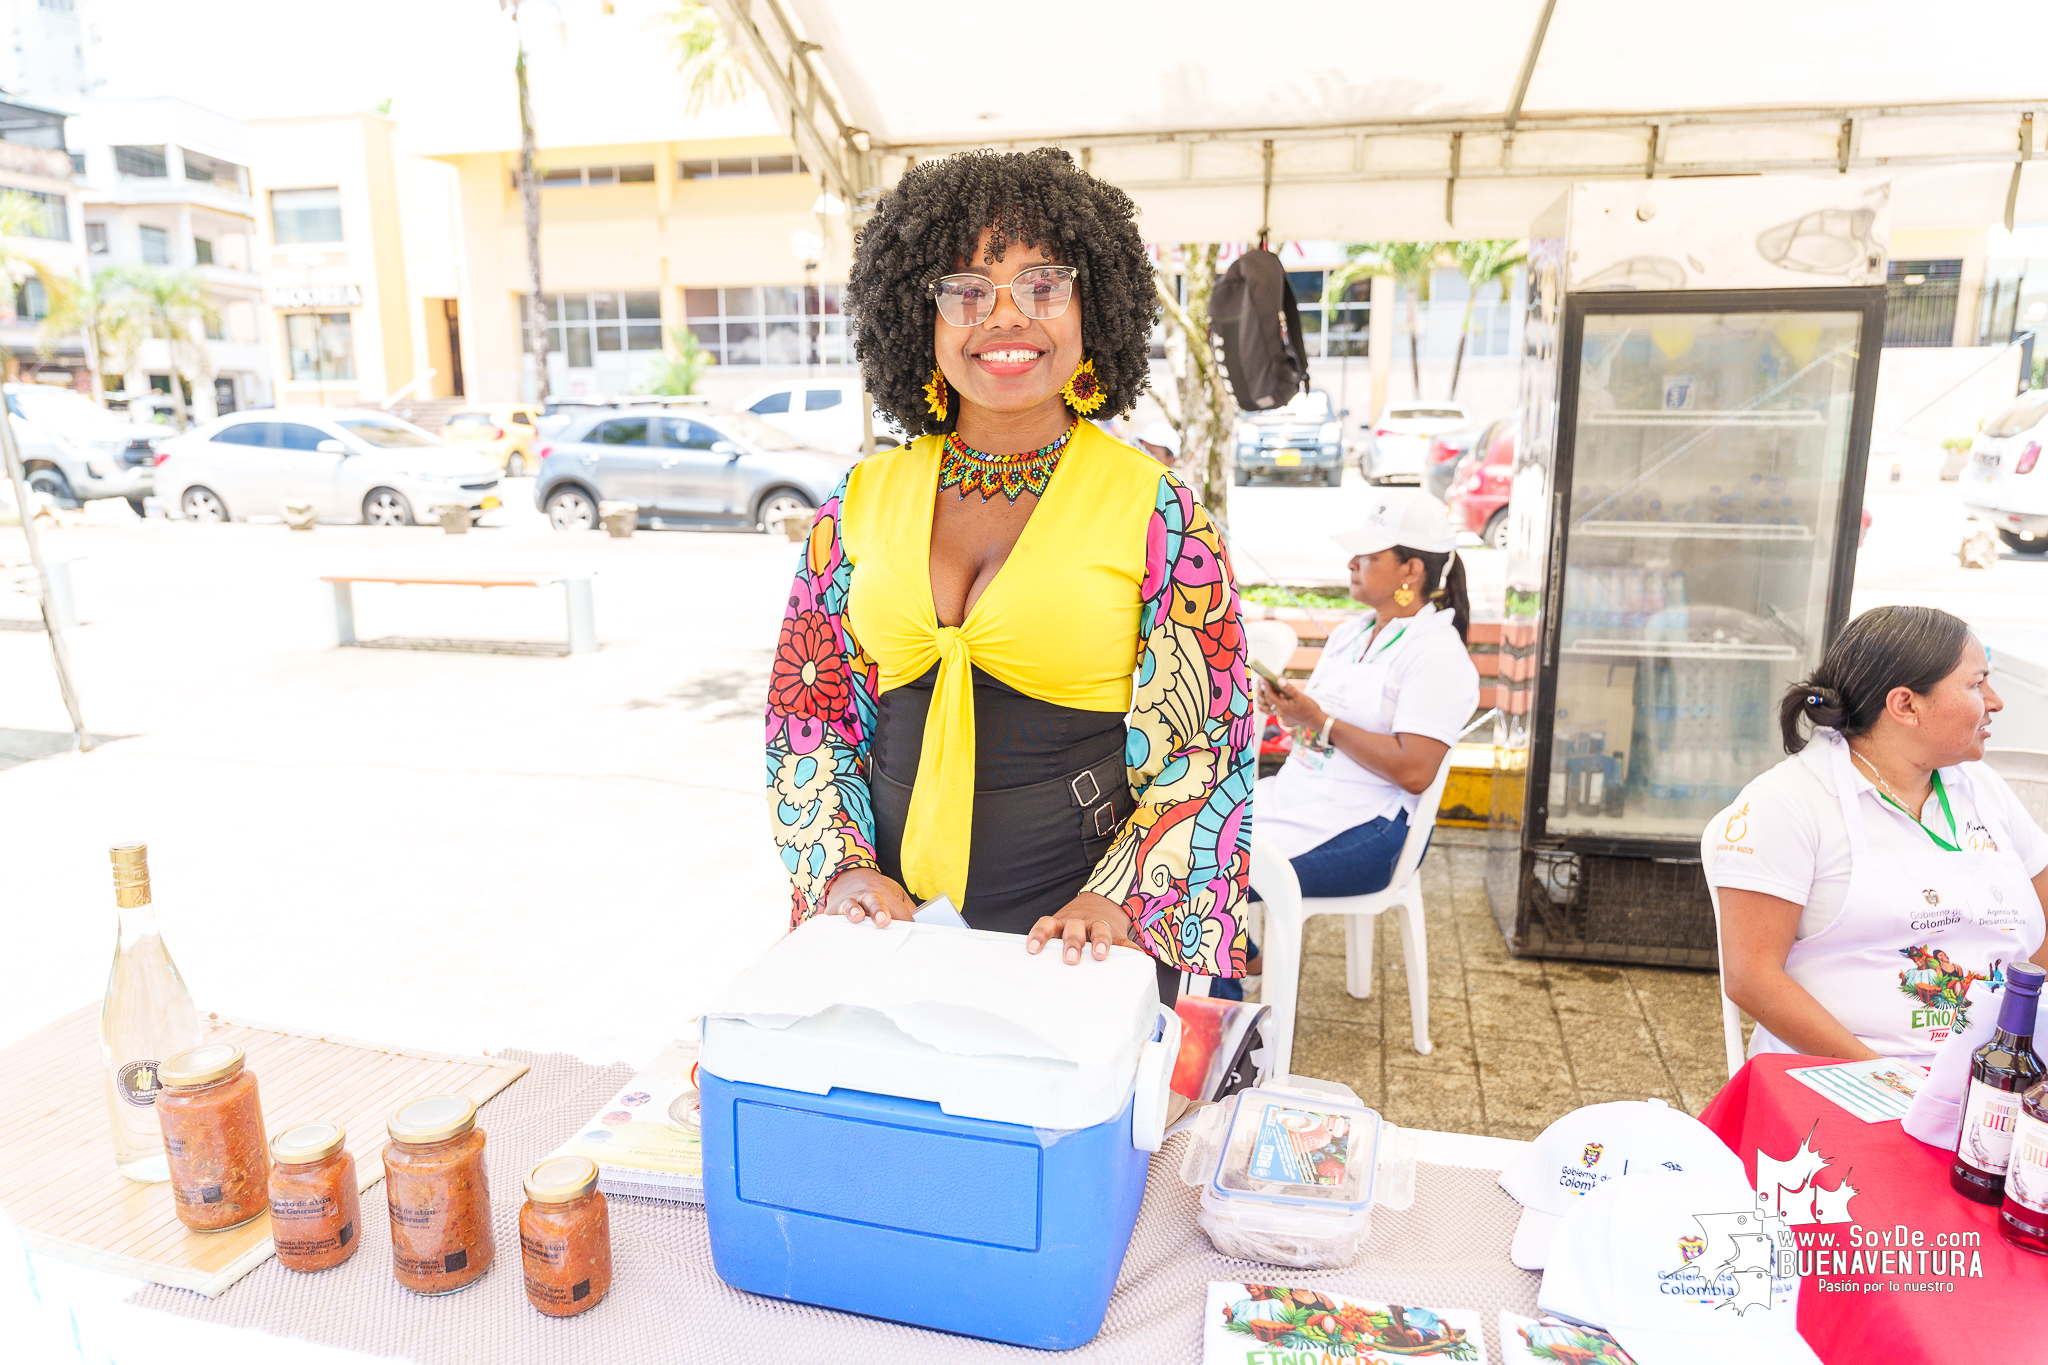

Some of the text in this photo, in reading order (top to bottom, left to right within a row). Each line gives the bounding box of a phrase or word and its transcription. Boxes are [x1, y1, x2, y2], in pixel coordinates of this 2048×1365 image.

[1910, 908, 1963, 920] Gobierno de
[1911, 916, 1961, 931] Colombia
[1985, 1101, 2018, 1116] MANOS
[2023, 1142, 2048, 1168] DIO
[1562, 1166, 1597, 1180] Gobierno
[310, 1197, 332, 1206] atún
[286, 1206, 326, 1215] Gourmet
[415, 1208, 436, 1216] atún
[396, 1212, 430, 1223] Gourmet
[311, 1240, 337, 1250] natural
[528, 1245, 559, 1259] Gourmet
[1658, 1270, 1704, 1281] Gobiern
[1246, 1351, 1405, 1365] ETNOA
